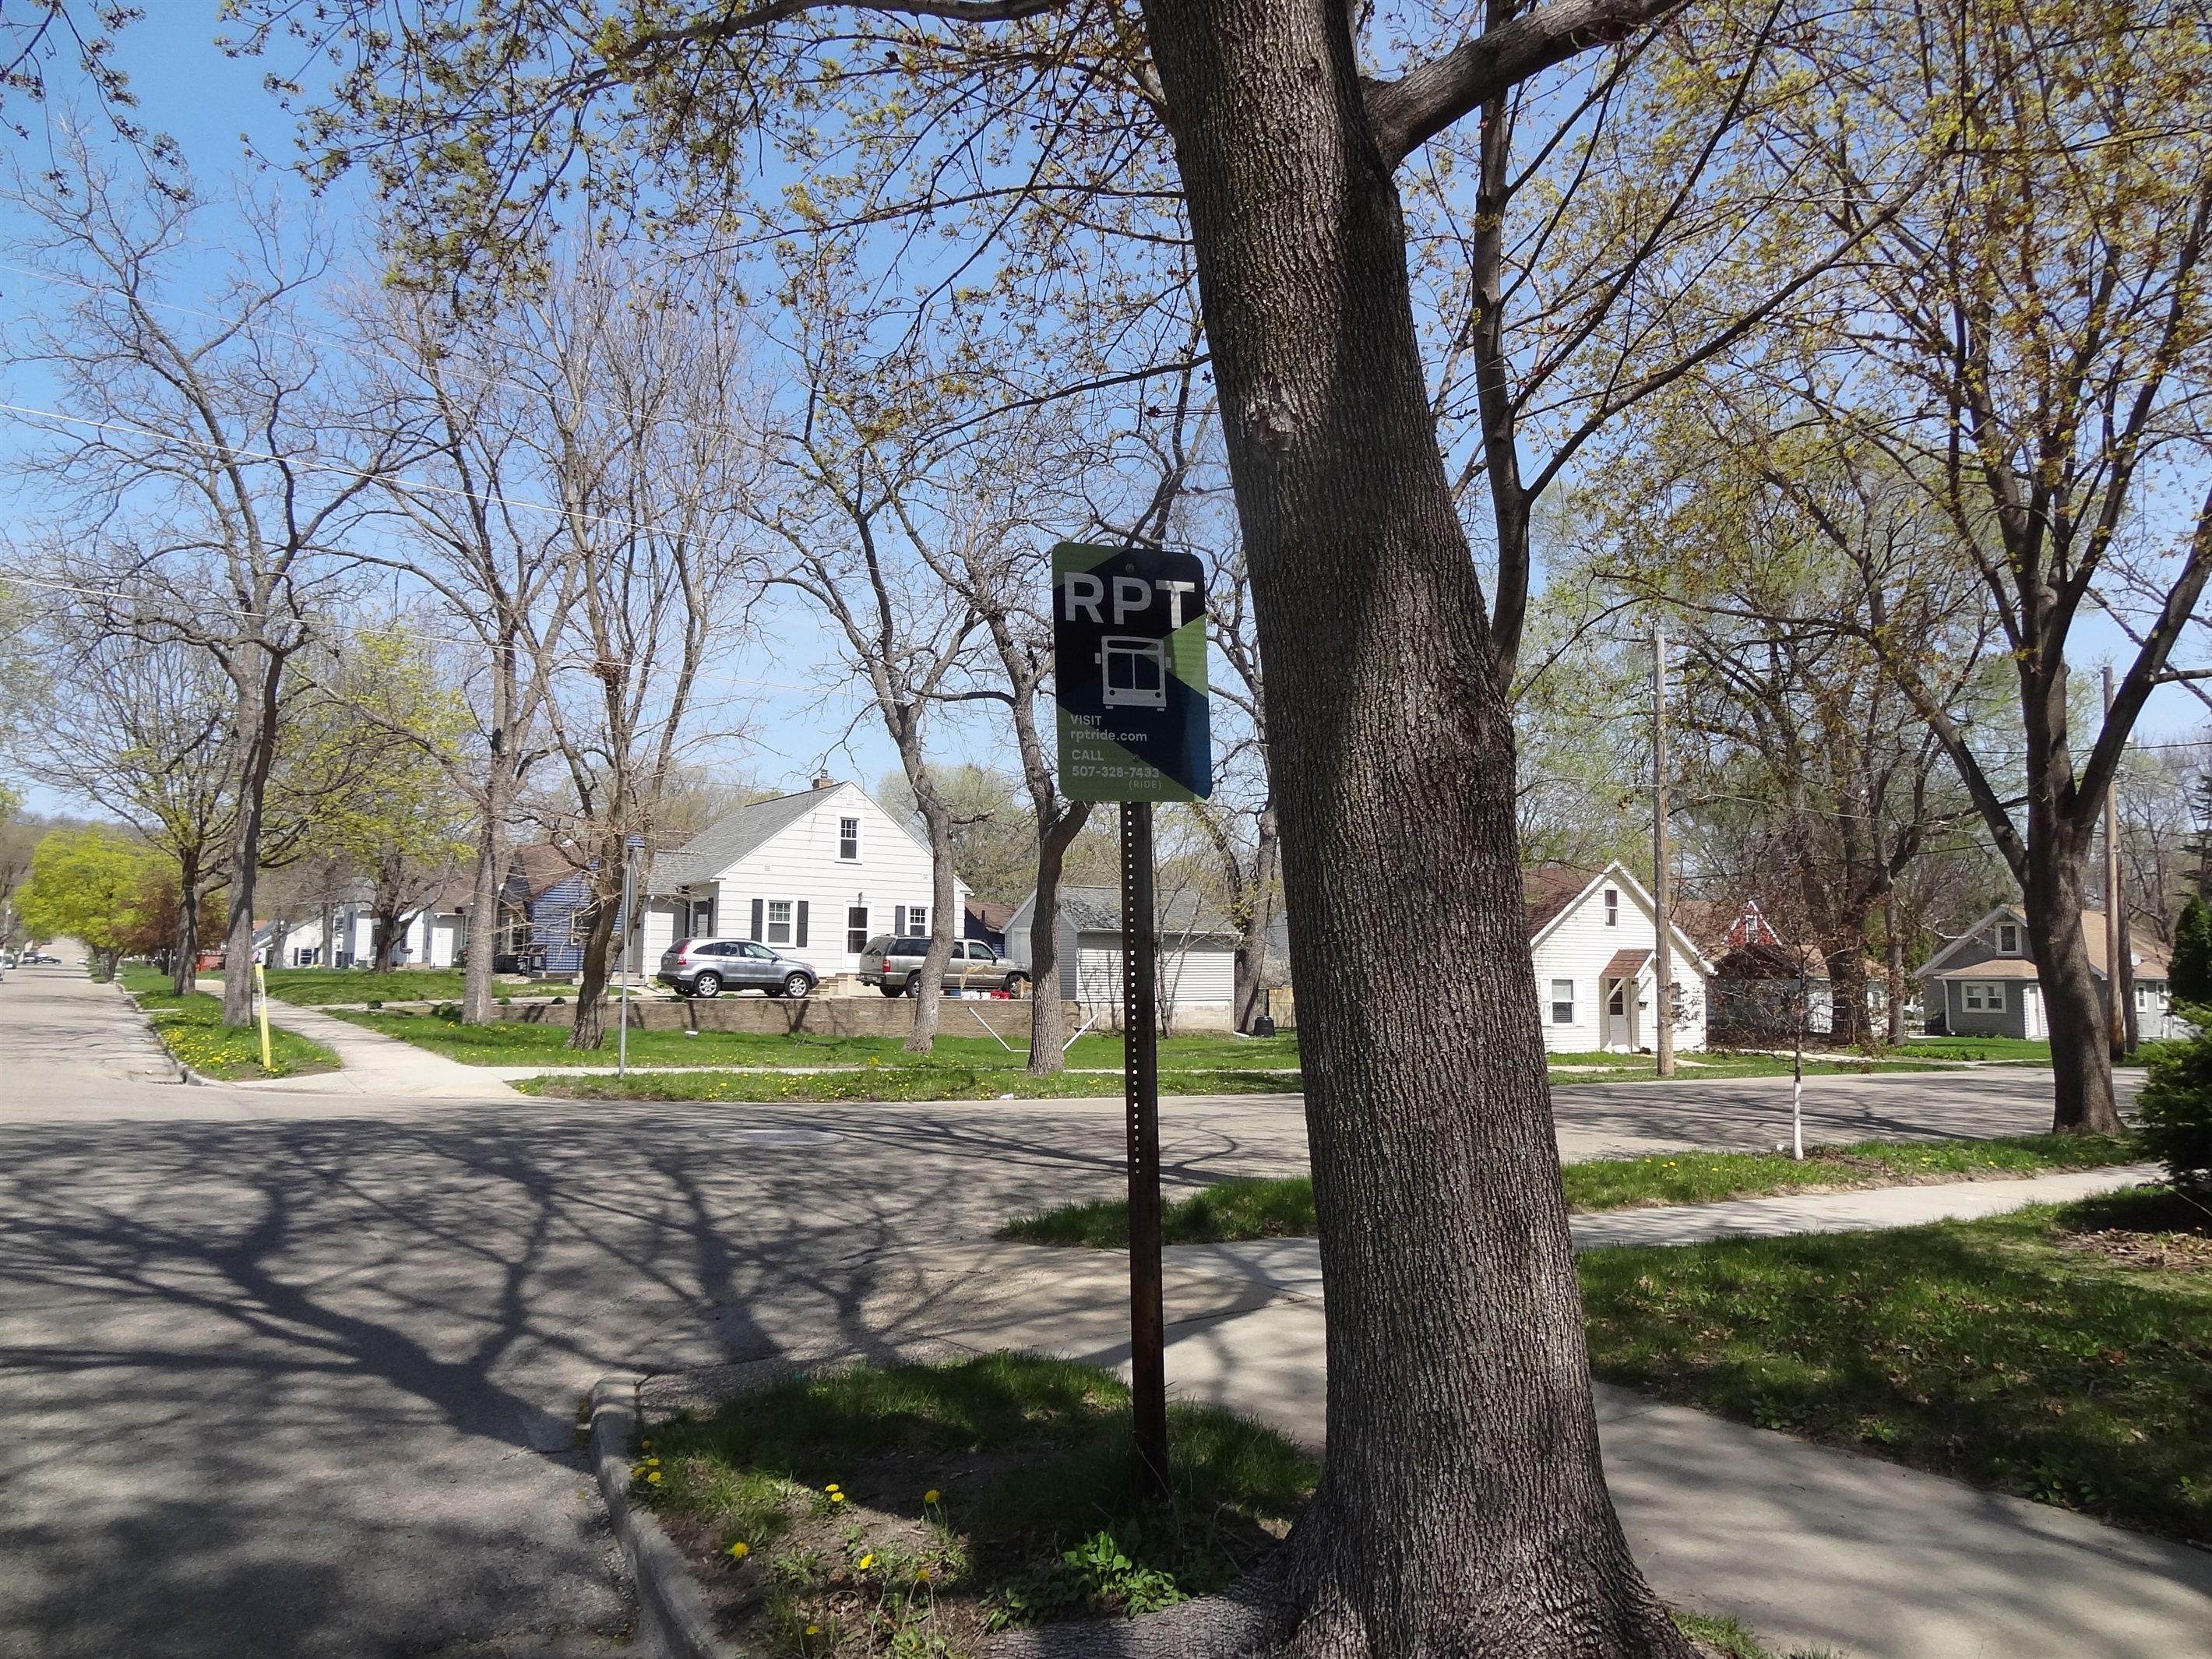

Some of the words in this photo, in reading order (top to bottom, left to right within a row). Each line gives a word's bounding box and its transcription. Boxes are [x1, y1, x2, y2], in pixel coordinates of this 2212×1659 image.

[1064, 572, 1195, 629] RPT
[1070, 714, 1102, 725] VISIT
[1070, 728, 1147, 742] rptride.com
[1071, 749, 1104, 761] CALL
[1072, 766, 1160, 778] 507-328-7433
[1129, 780, 1161, 791] (RIDE)
